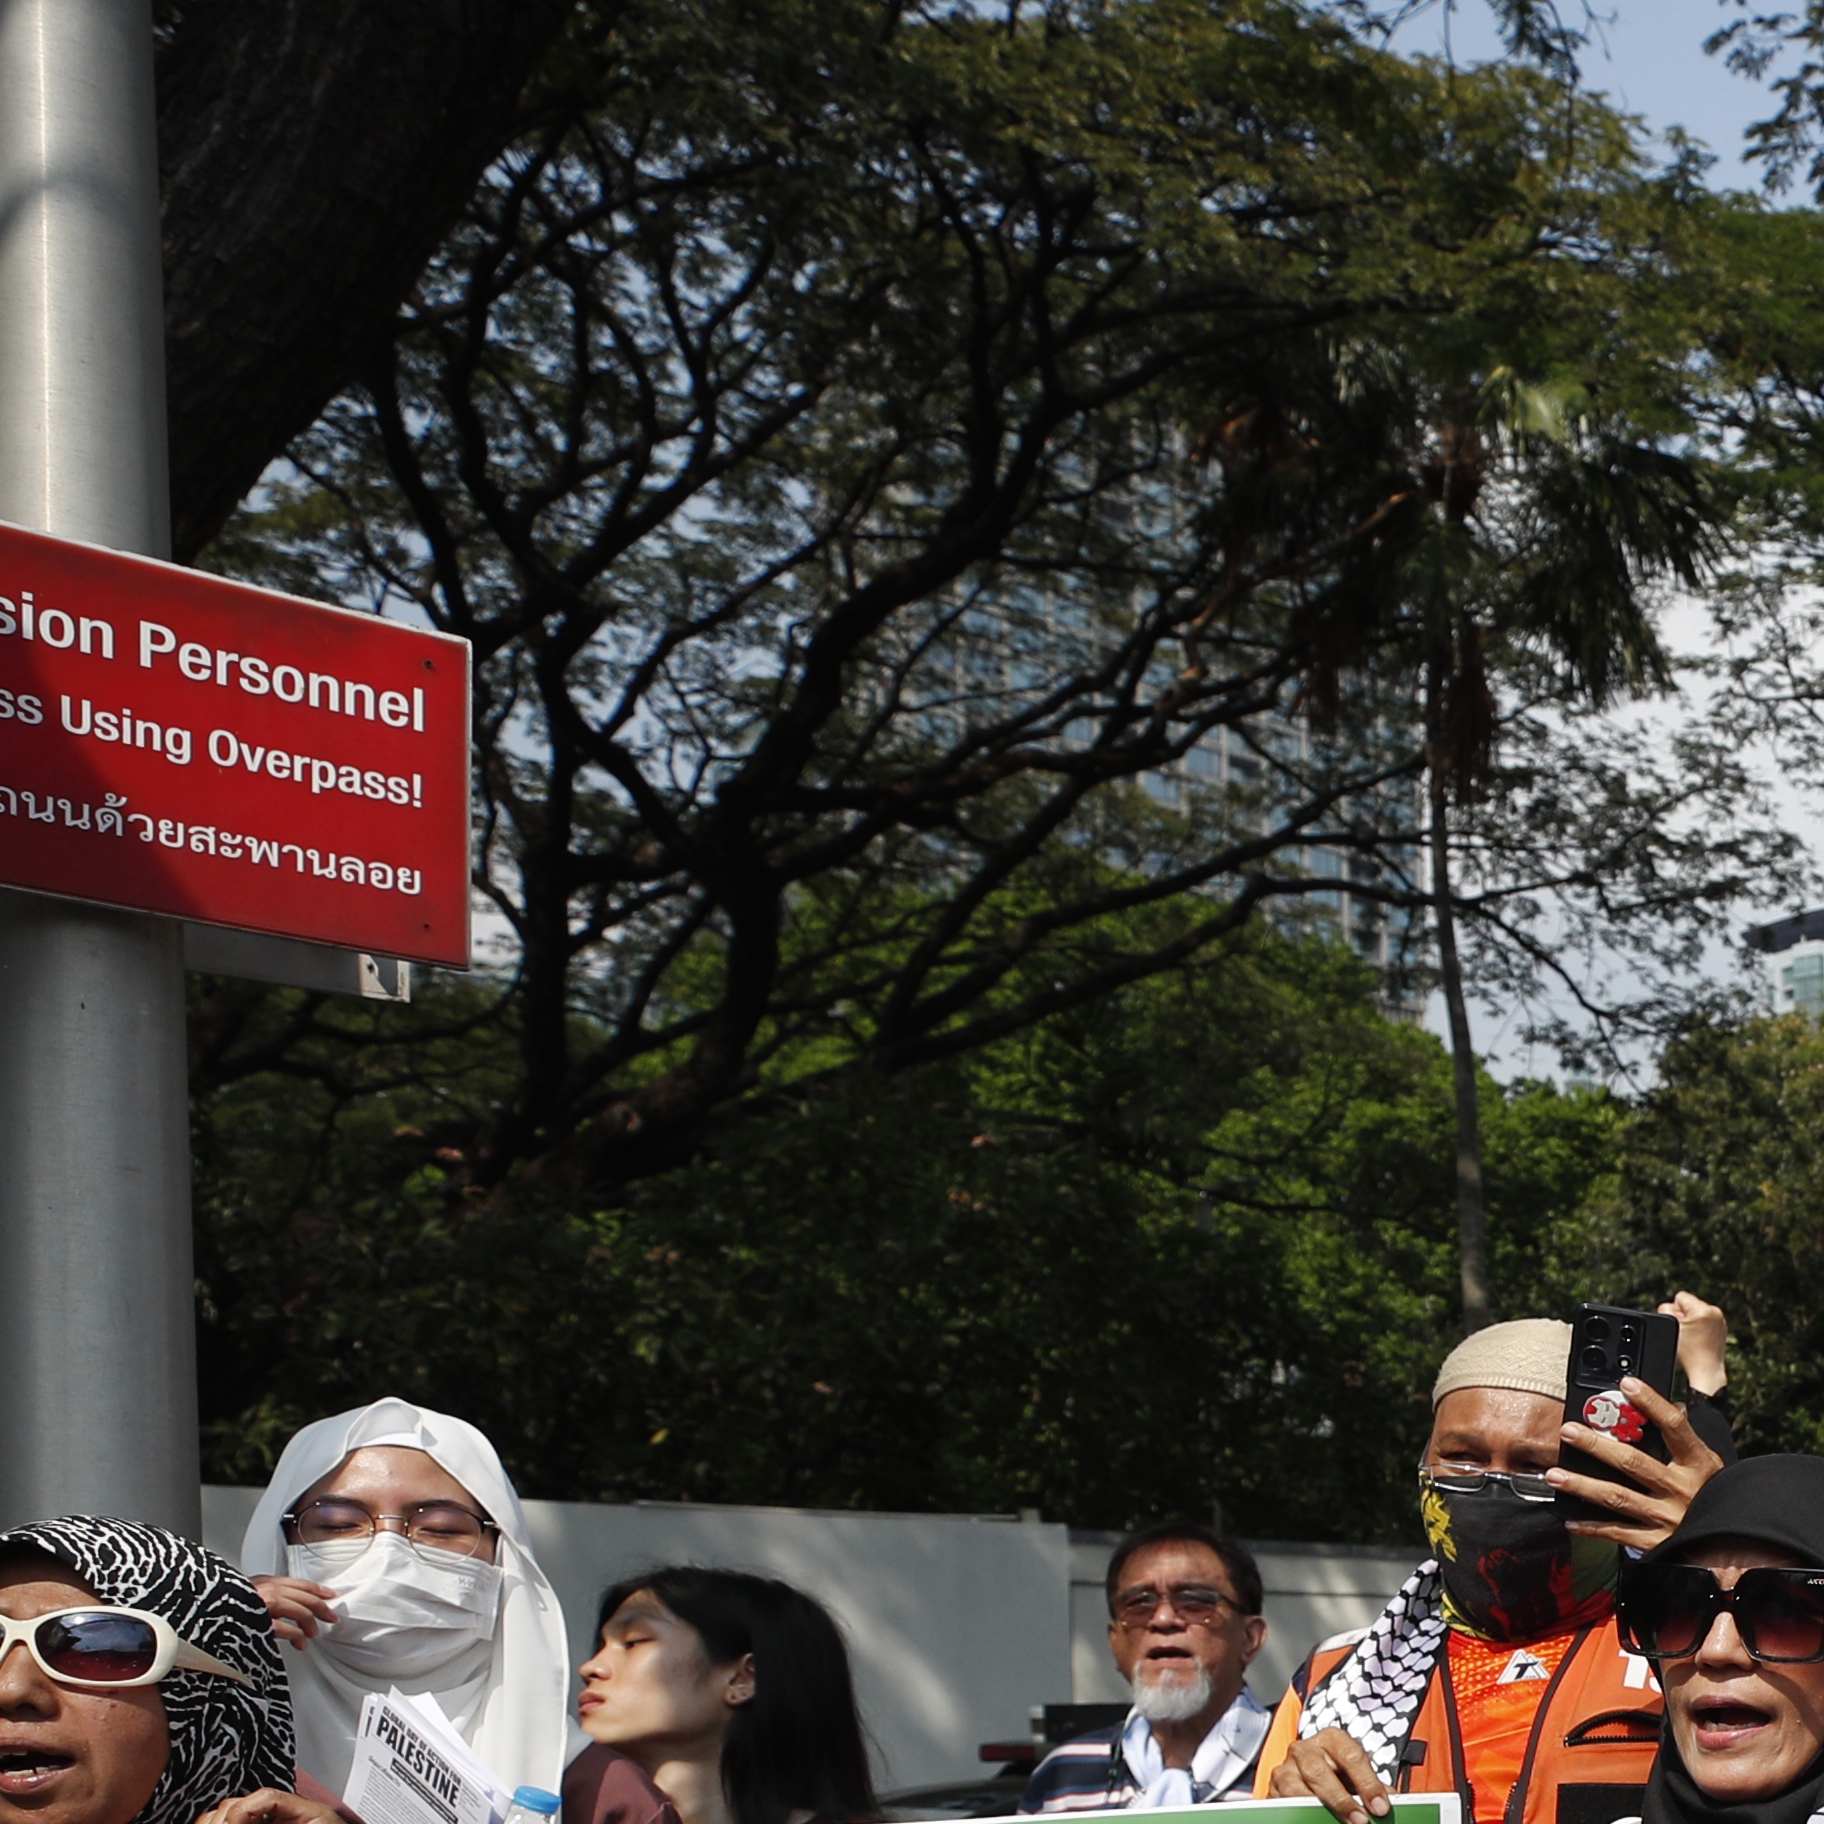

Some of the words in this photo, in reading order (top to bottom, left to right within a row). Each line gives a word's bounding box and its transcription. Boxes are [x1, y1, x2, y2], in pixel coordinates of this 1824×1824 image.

[139, 621, 425, 732] Personnel
[61, 694, 192, 766] Using
[208, 730, 422, 808] Overpass!
[376, 1715, 460, 1808] PALESTINE
